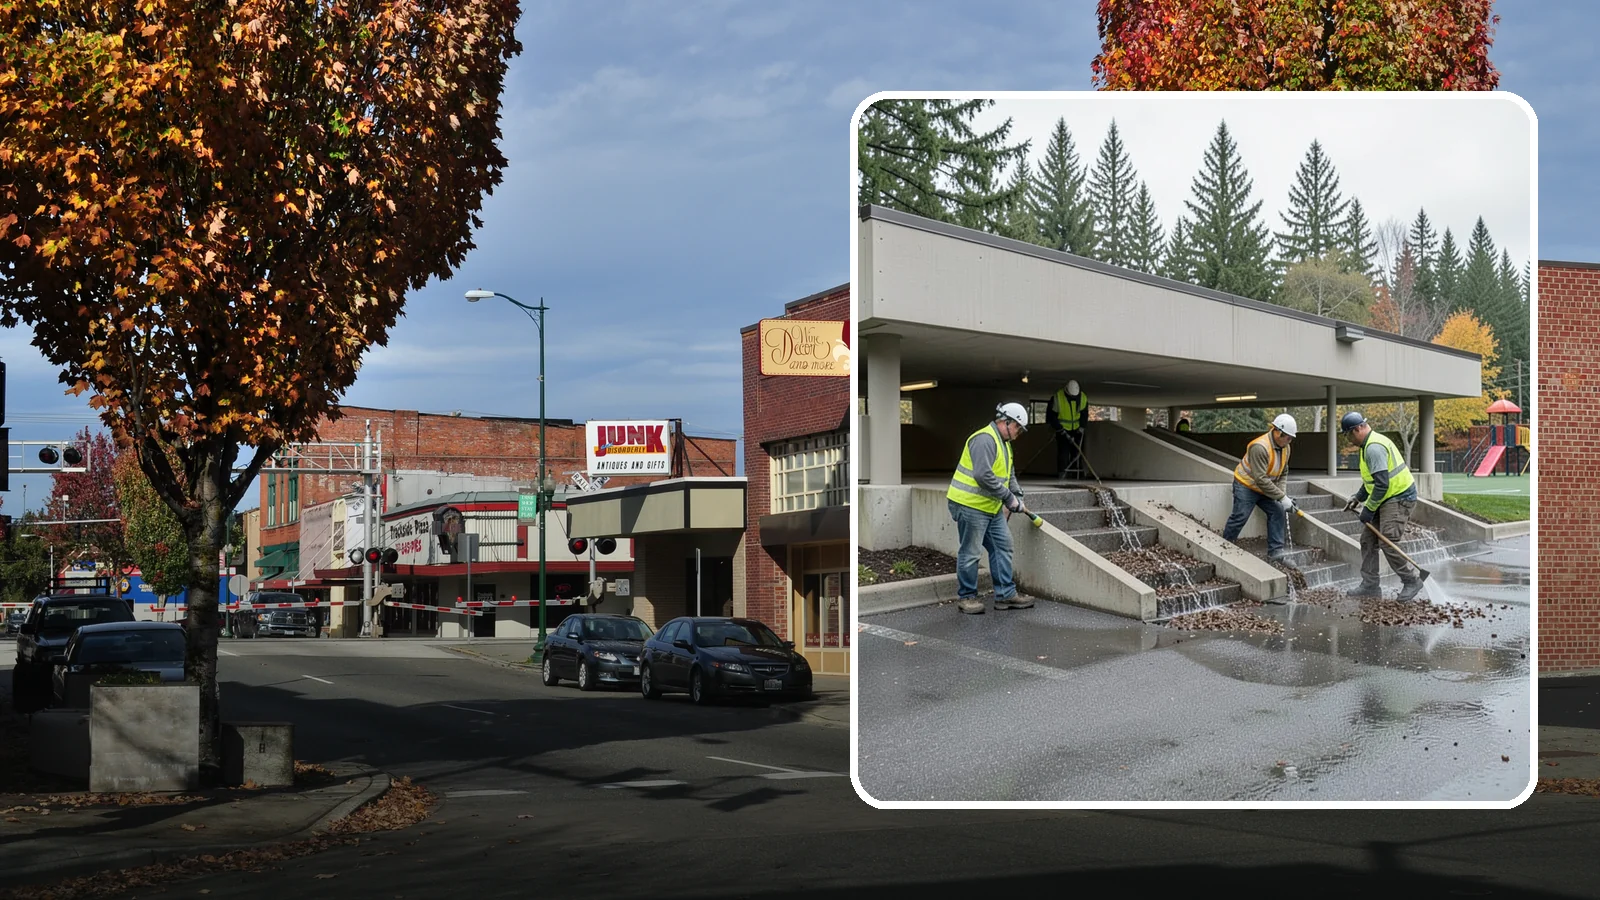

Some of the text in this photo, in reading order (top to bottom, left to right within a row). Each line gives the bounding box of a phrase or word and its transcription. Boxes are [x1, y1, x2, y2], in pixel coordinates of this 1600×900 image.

[765, 327, 831, 365] Decor
[595, 425, 665, 457] JUNK
[607, 446, 646, 454] DISORDERLY
[597, 460, 665, 470] ANTIQUES AND GIFTS
[414, 519, 429, 535] Pizza
